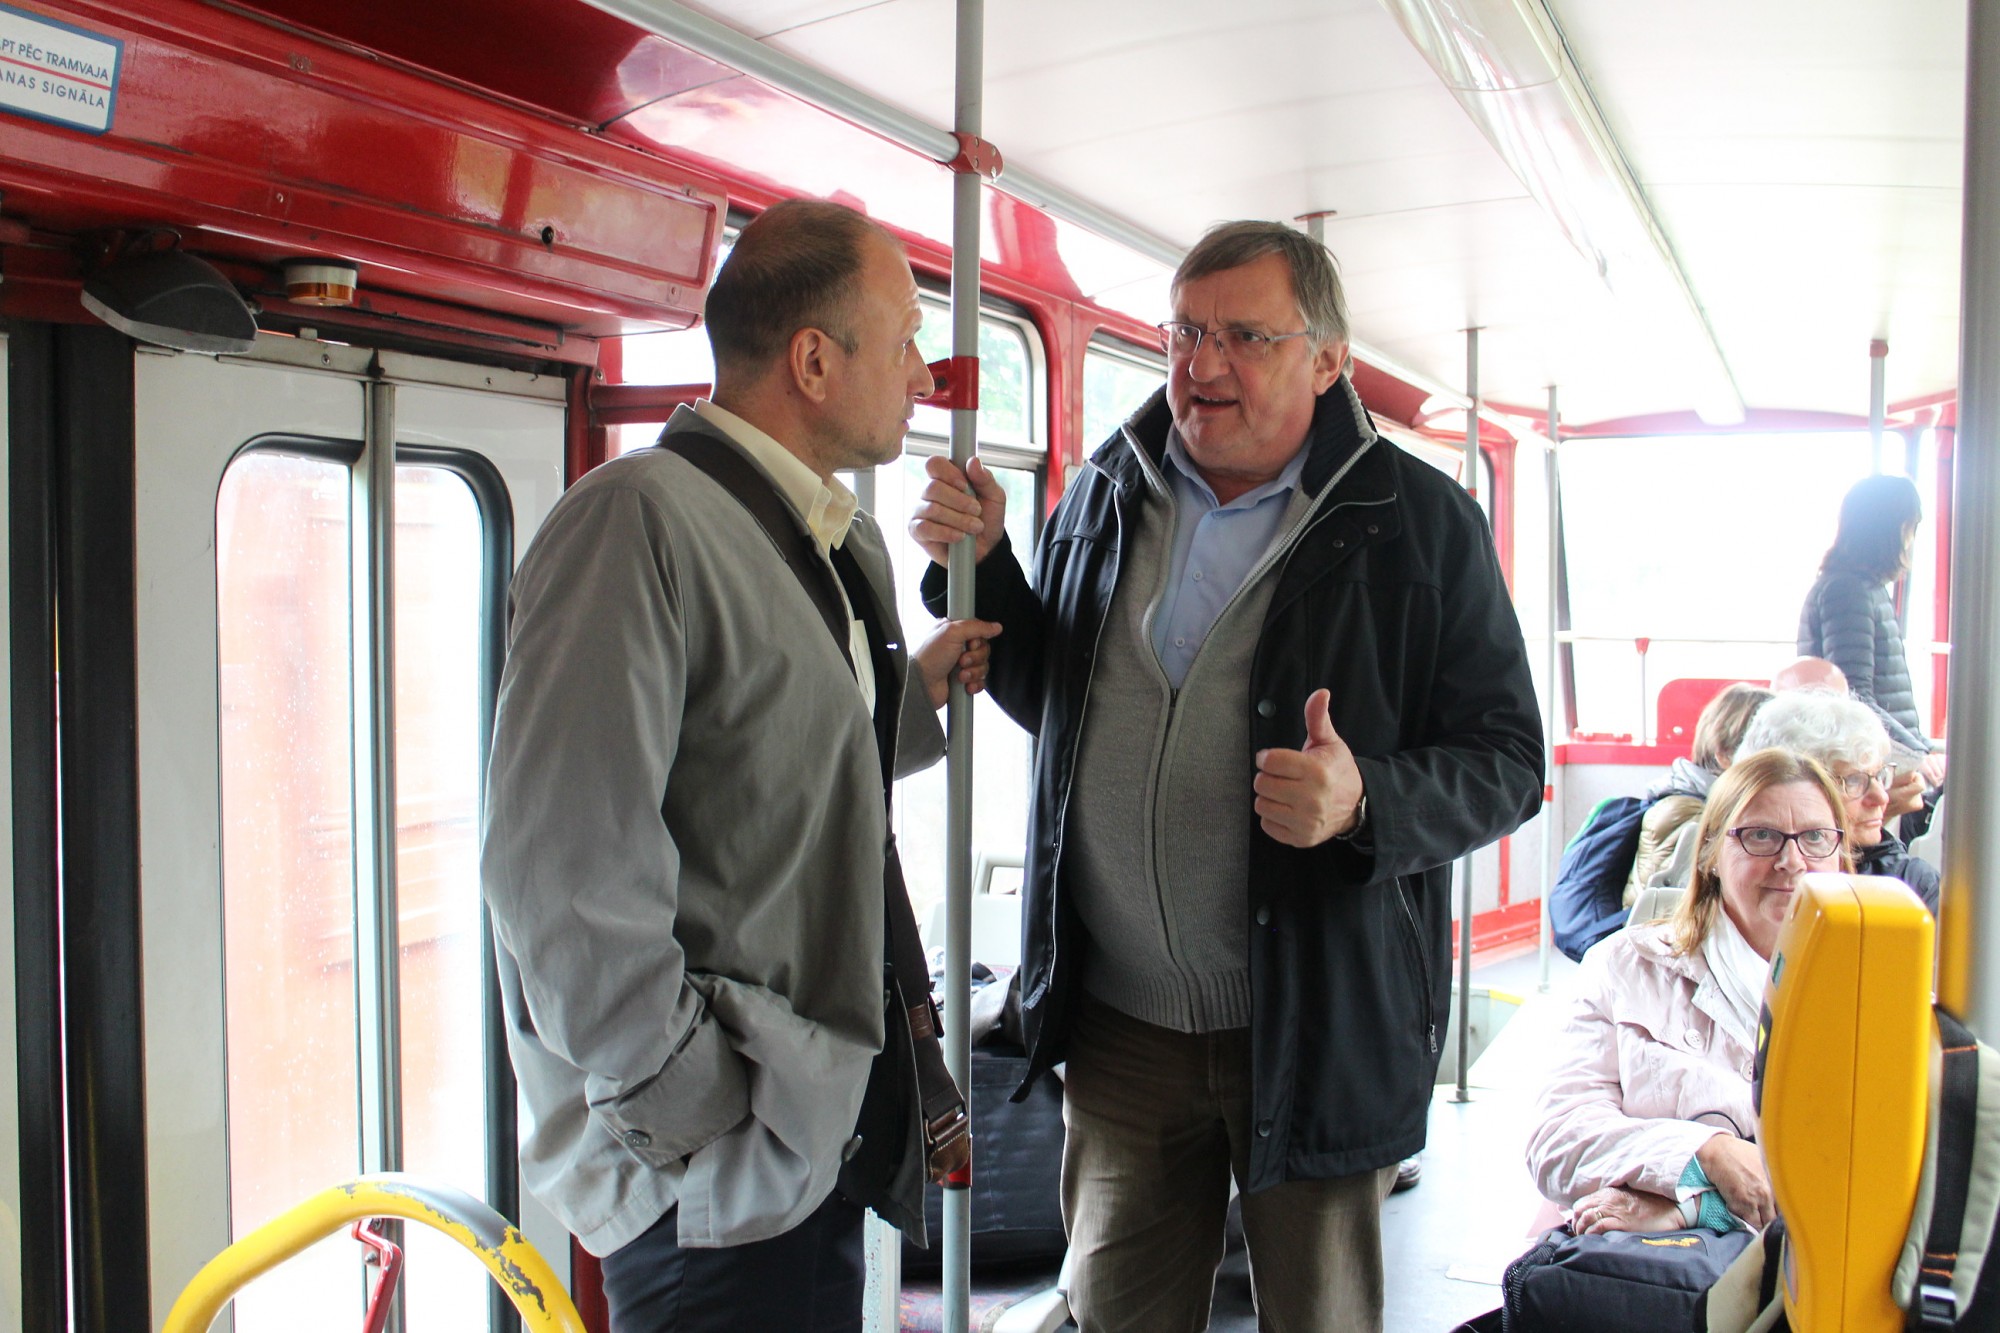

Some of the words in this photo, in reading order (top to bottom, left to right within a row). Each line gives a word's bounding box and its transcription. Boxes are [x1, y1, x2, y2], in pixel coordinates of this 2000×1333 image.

[0, 39, 15, 53] PT
[19, 43, 42, 61] PĒC
[46, 51, 108, 81] TRAMVAJA
[42, 80, 104, 109] SIGNĀLA
